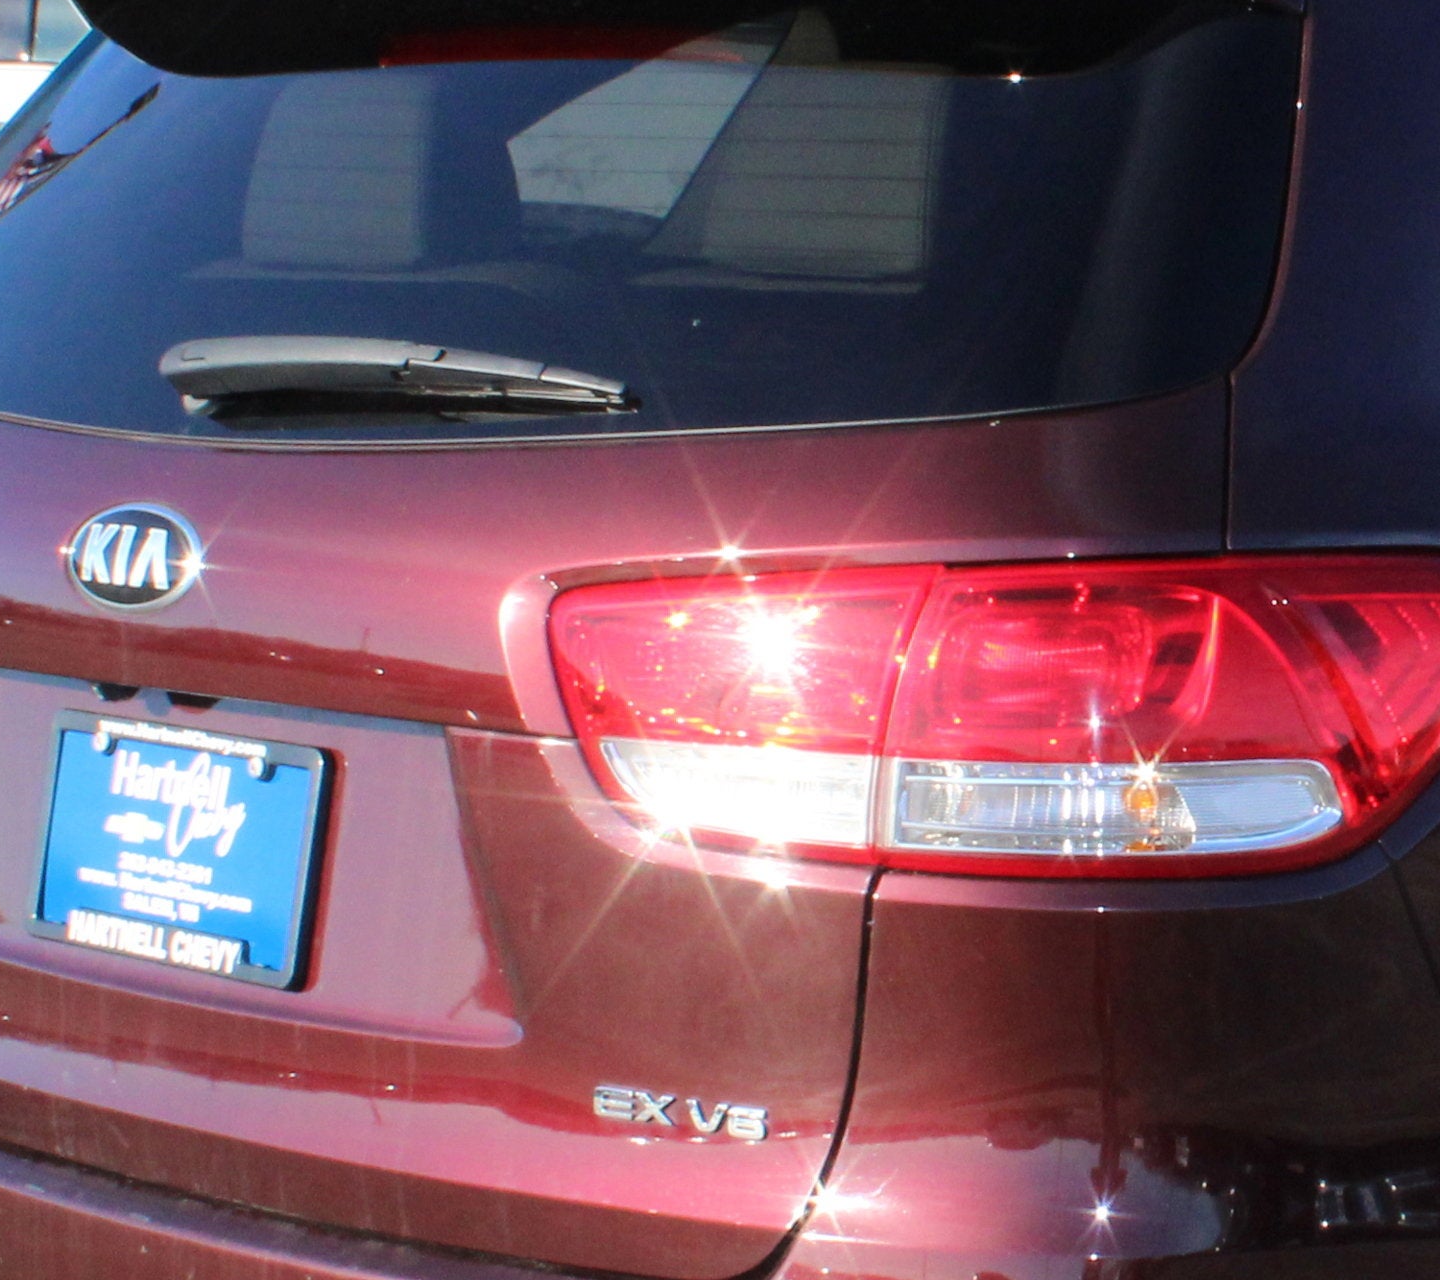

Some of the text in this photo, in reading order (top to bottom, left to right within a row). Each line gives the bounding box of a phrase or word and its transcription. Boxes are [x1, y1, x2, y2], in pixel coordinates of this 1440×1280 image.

[80, 522, 171, 590] KIA
[110, 749, 232, 812] Hartnell
[65, 909, 241, 973] HARTNELL CHEVY
[593, 1085, 769, 1141] EX V6
